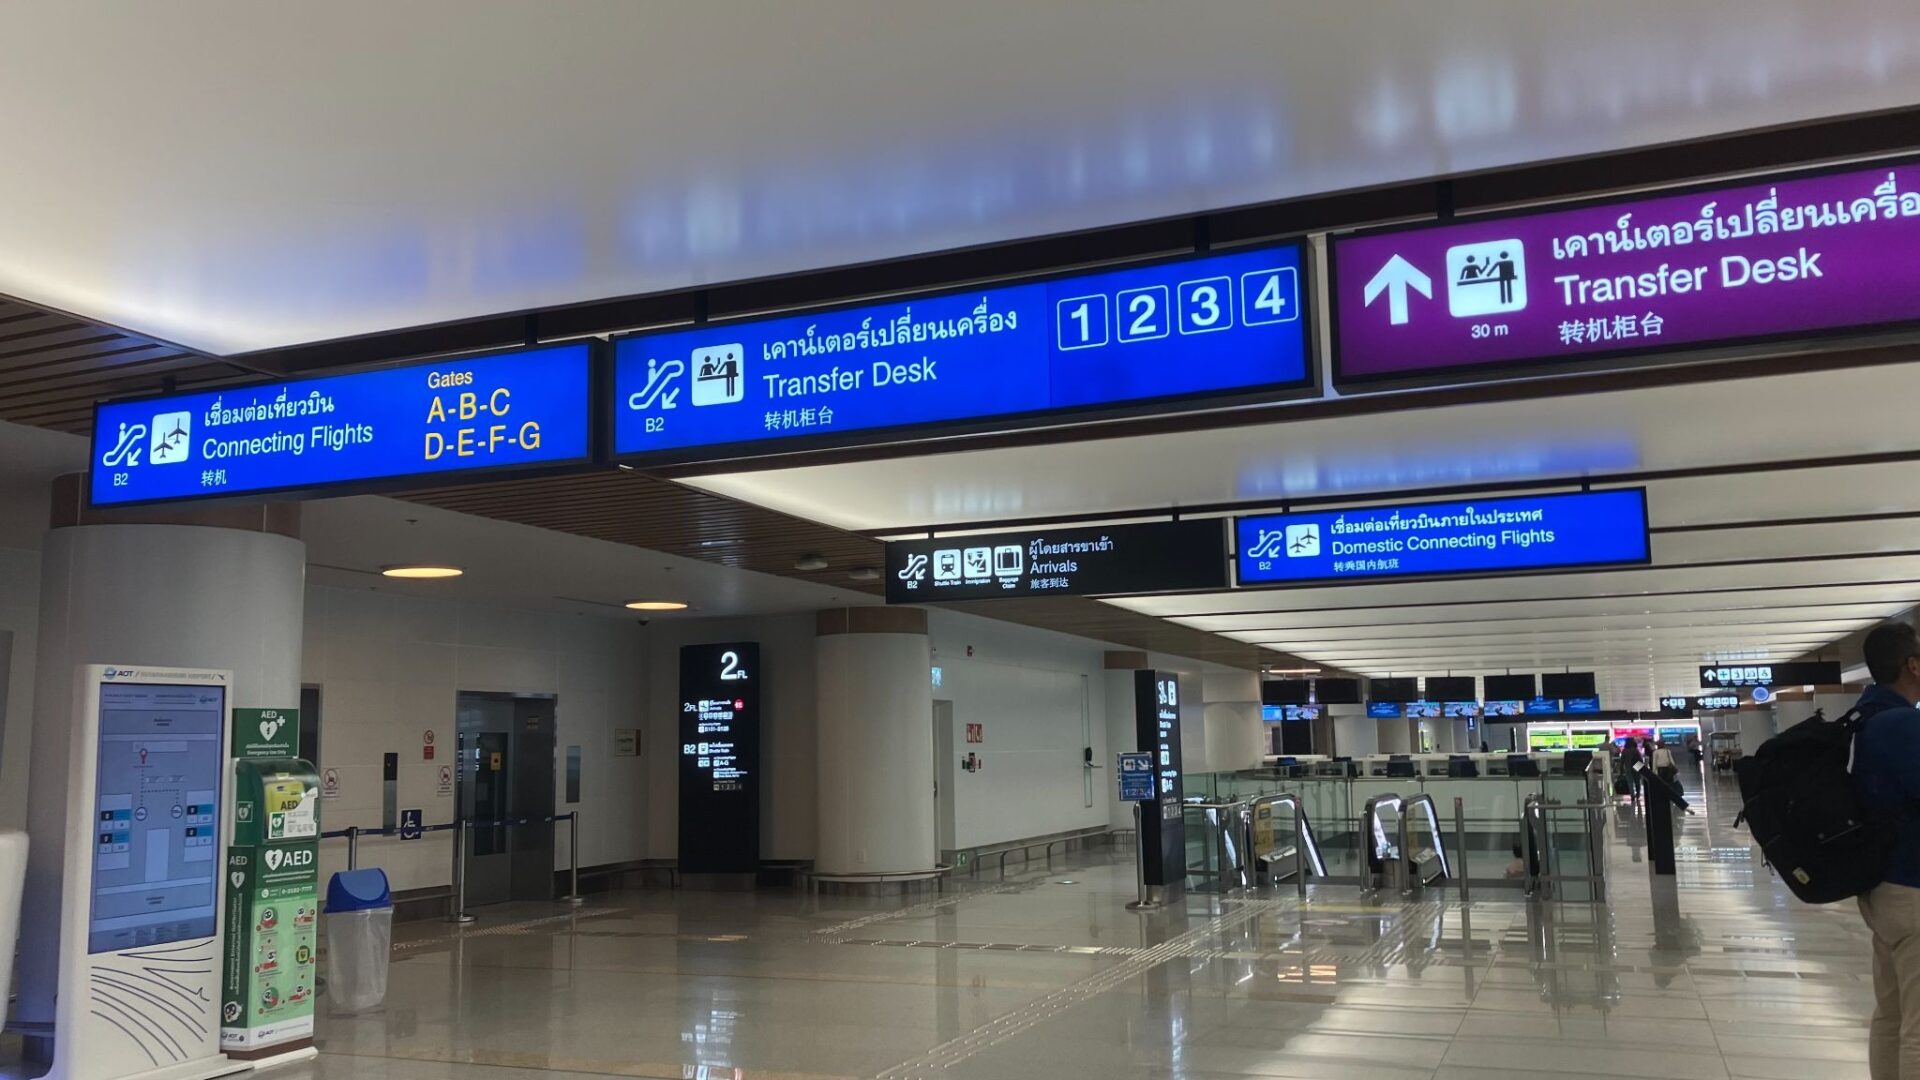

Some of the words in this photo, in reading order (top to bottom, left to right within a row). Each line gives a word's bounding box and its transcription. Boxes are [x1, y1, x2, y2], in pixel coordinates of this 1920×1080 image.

[1554, 263, 1708, 306] Transfer
[1721, 247, 1823, 288] Desk
[1070, 303, 1089, 342] 1
[1128, 294, 1157, 335] 2
[1190, 285, 1220, 326] 3
[1254, 275, 1285, 315] 4
[763, 296, 1017, 361] เคาน์เตอร์เปลี่ยนเครื่อง
[1471, 323, 1491, 338] 30
[1494, 323, 1508, 336] m
[1557, 311, 1664, 345] 转机柜台
[427, 371, 473, 389] Gates
[763, 366, 864, 399] Transfer
[872, 356, 937, 387] Desk
[204, 387, 334, 427] เชื่อมต่อเที่ยวบิน
[426, 388, 510, 424] A-B-C
[764, 405, 834, 431] 转机柜台
[645, 416, 665, 433] B2
[202, 431, 304, 460] Connecting
[311, 423, 373, 452] Flights
[425, 421, 540, 460] D-E-F-G
[113, 472, 128, 487] B2
[200, 468, 227, 487] 转机
[1330, 506, 1543, 535] เชื่อมต่อเที่ยวบินภายในประเทศ
[1029, 535, 1113, 560] ผู้โดยสารขาเข้า
[1332, 539, 1403, 556] Domestic
[1406, 533, 1496, 551] Connecting
[1501, 529, 1555, 547] Flights
[1030, 559, 1077, 574] Arrivals
[1258, 561, 1271, 570] B2
[907, 581, 917, 589] B2
[261, 710, 277, 719] AED
[683, 744, 696, 754] B2
[229, 855, 248, 866] AED
[282, 850, 313, 867] AED
